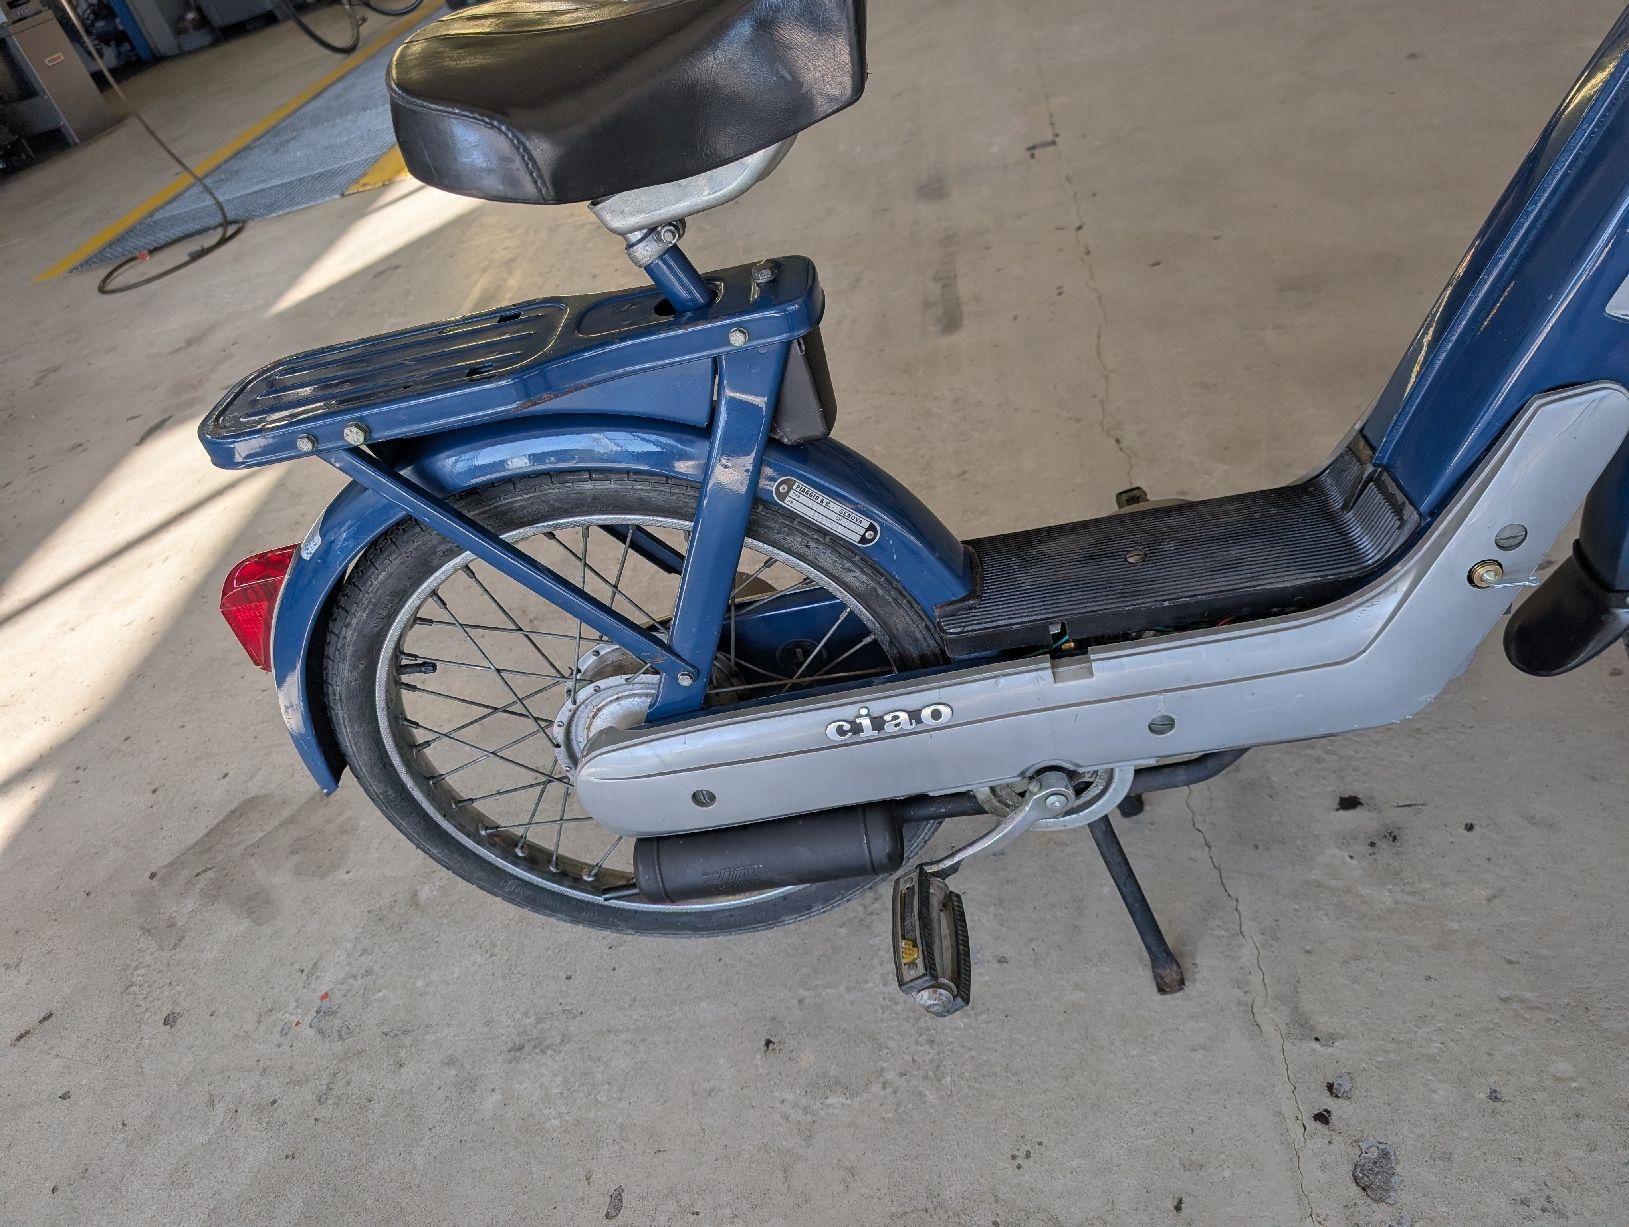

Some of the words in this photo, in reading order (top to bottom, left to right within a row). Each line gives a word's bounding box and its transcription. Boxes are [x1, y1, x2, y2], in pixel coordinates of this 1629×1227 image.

[795, 484, 820, 501] PIAGGIO
[838, 508, 863, 525] GENOVA
[825, 704, 953, 741] ciao
